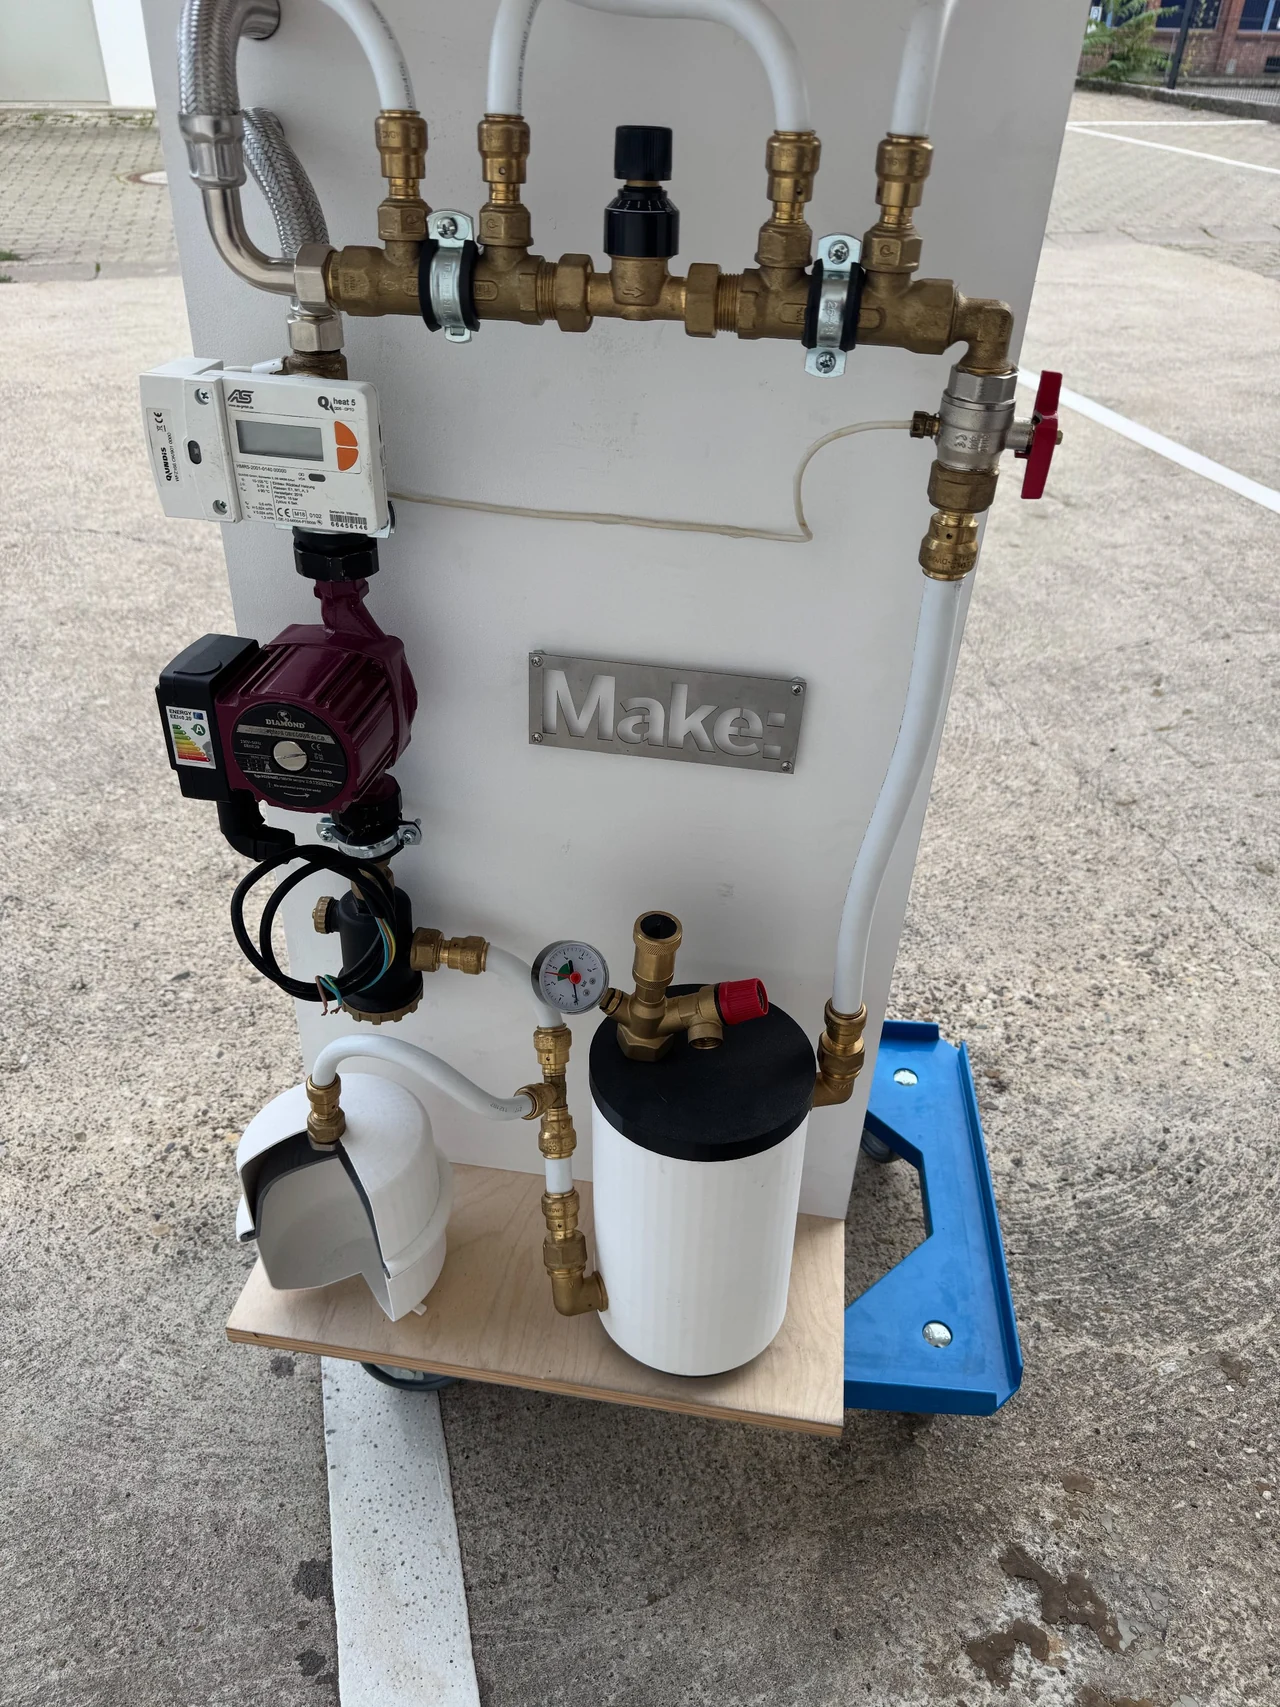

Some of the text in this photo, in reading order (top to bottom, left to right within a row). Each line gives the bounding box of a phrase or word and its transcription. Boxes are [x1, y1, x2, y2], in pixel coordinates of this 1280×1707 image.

[228, 389, 254, 404] AS
[333, 398, 349, 406] heat
[351, 398, 356, 406] 5
[542, 668, 786, 760] Make:
[265, 718, 304, 728] DIAMOND
